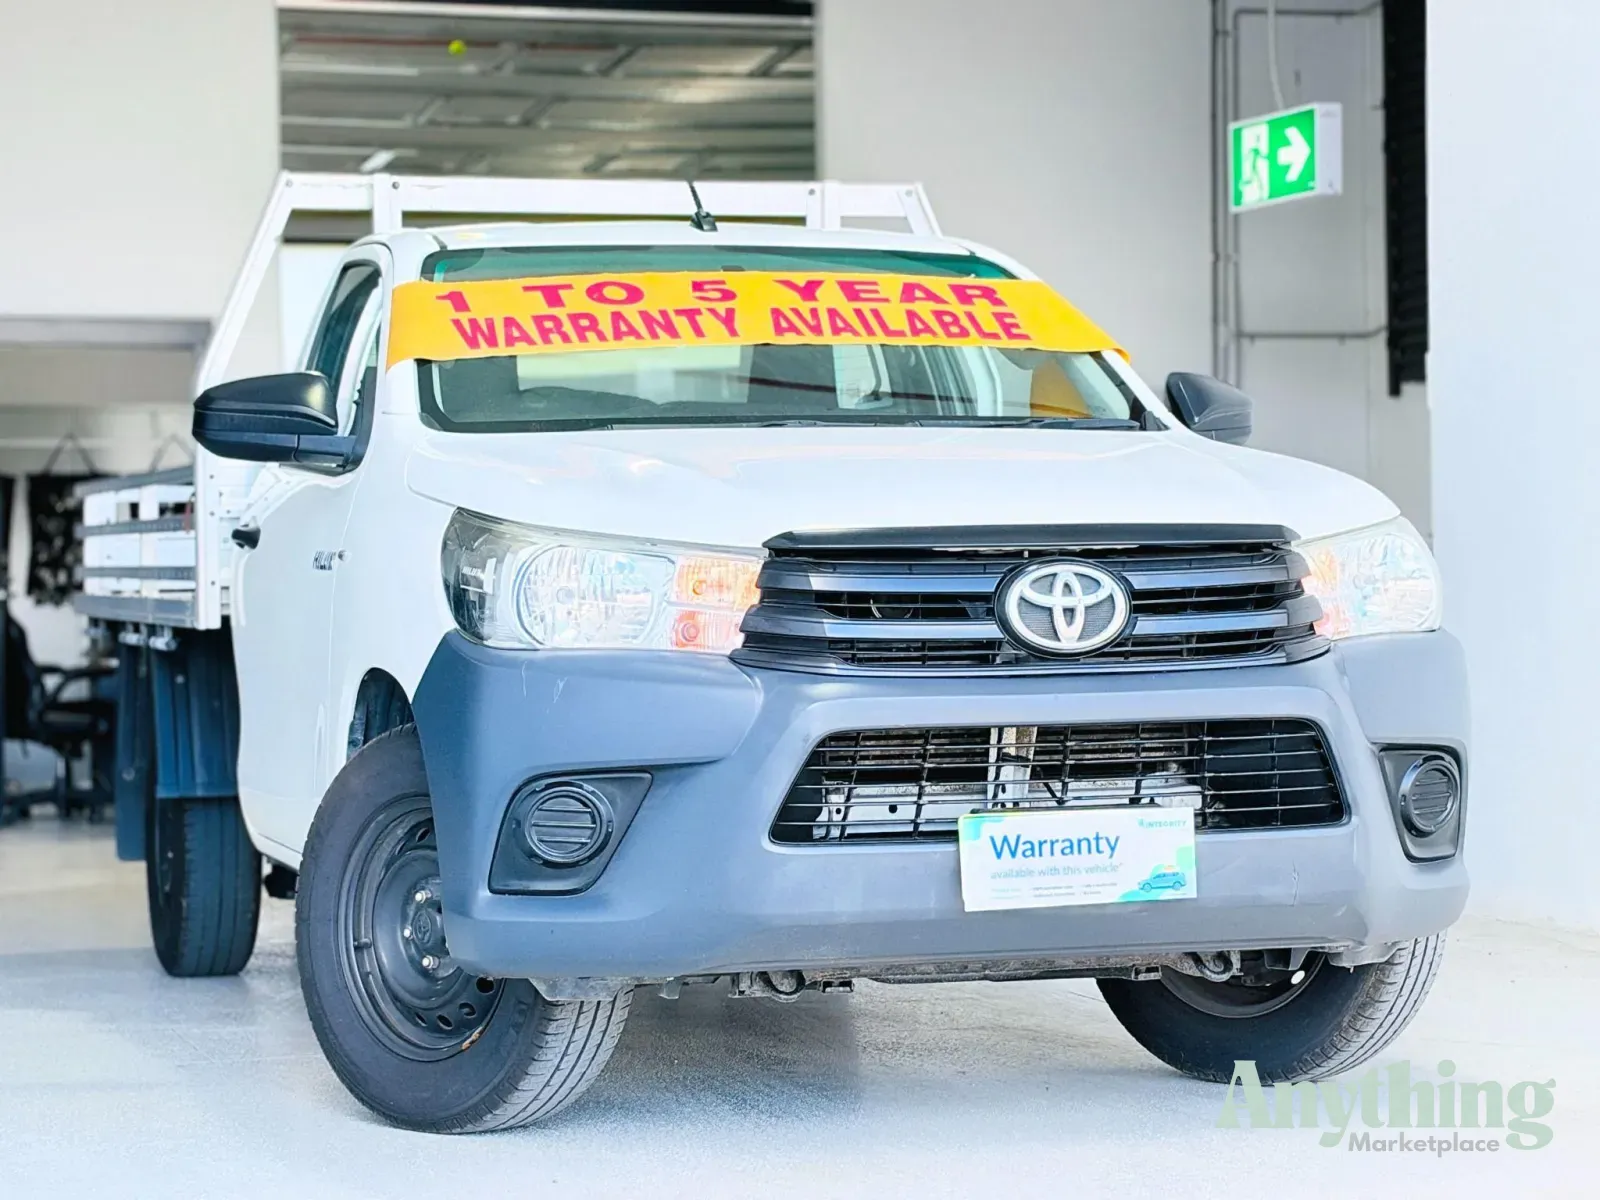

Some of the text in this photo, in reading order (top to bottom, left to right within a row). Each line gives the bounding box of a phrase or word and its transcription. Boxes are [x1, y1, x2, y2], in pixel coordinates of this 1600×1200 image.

[436, 280, 1007, 312] 1 TO 5 YEAR
[451, 307, 1032, 349] WARRANTY AVAILABLE
[989, 831, 1120, 860] Warranty
[990, 866, 1035, 879] available
[1038, 865, 1060, 876] with
[1062, 864, 1081, 875] this
